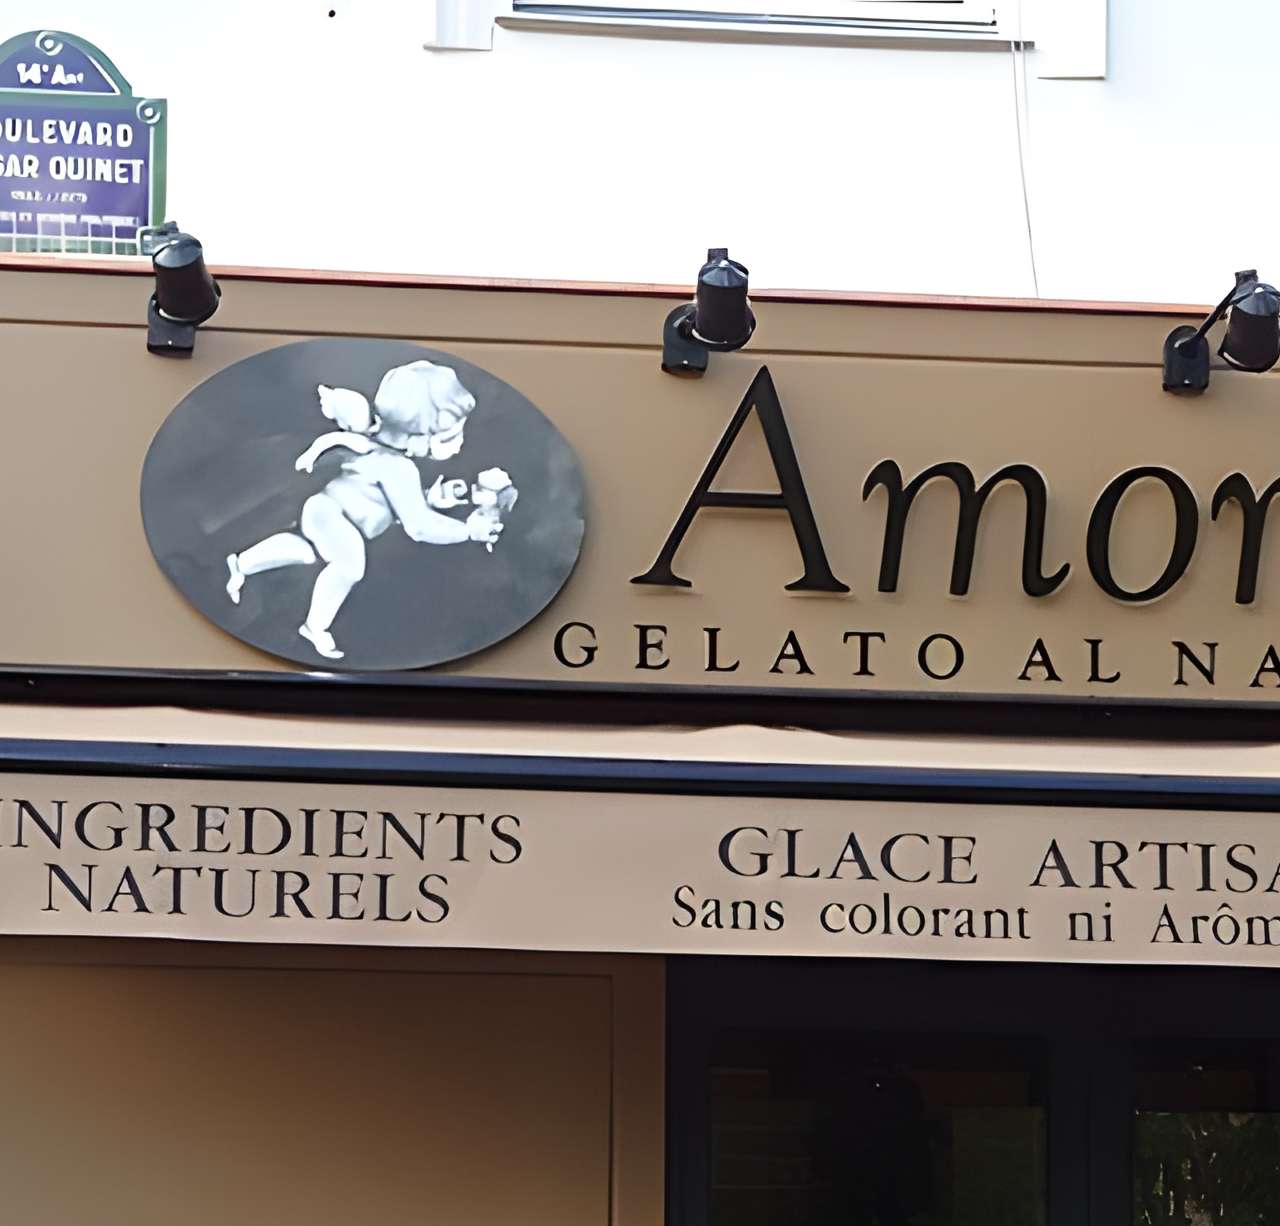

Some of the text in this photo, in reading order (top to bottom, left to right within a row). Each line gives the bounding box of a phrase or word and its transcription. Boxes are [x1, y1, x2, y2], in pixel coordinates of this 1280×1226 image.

[49, 155, 144, 184] QUINET
[552, 621, 966, 682] GELATO
[1018, 636, 1122, 685] AL
[717, 825, 978, 888] GLACE
[40, 862, 451, 923] NATURELS
[671, 885, 786, 932] Sans
[819, 893, 1030, 941] colorant
[1067, 903, 1115, 943] ni
